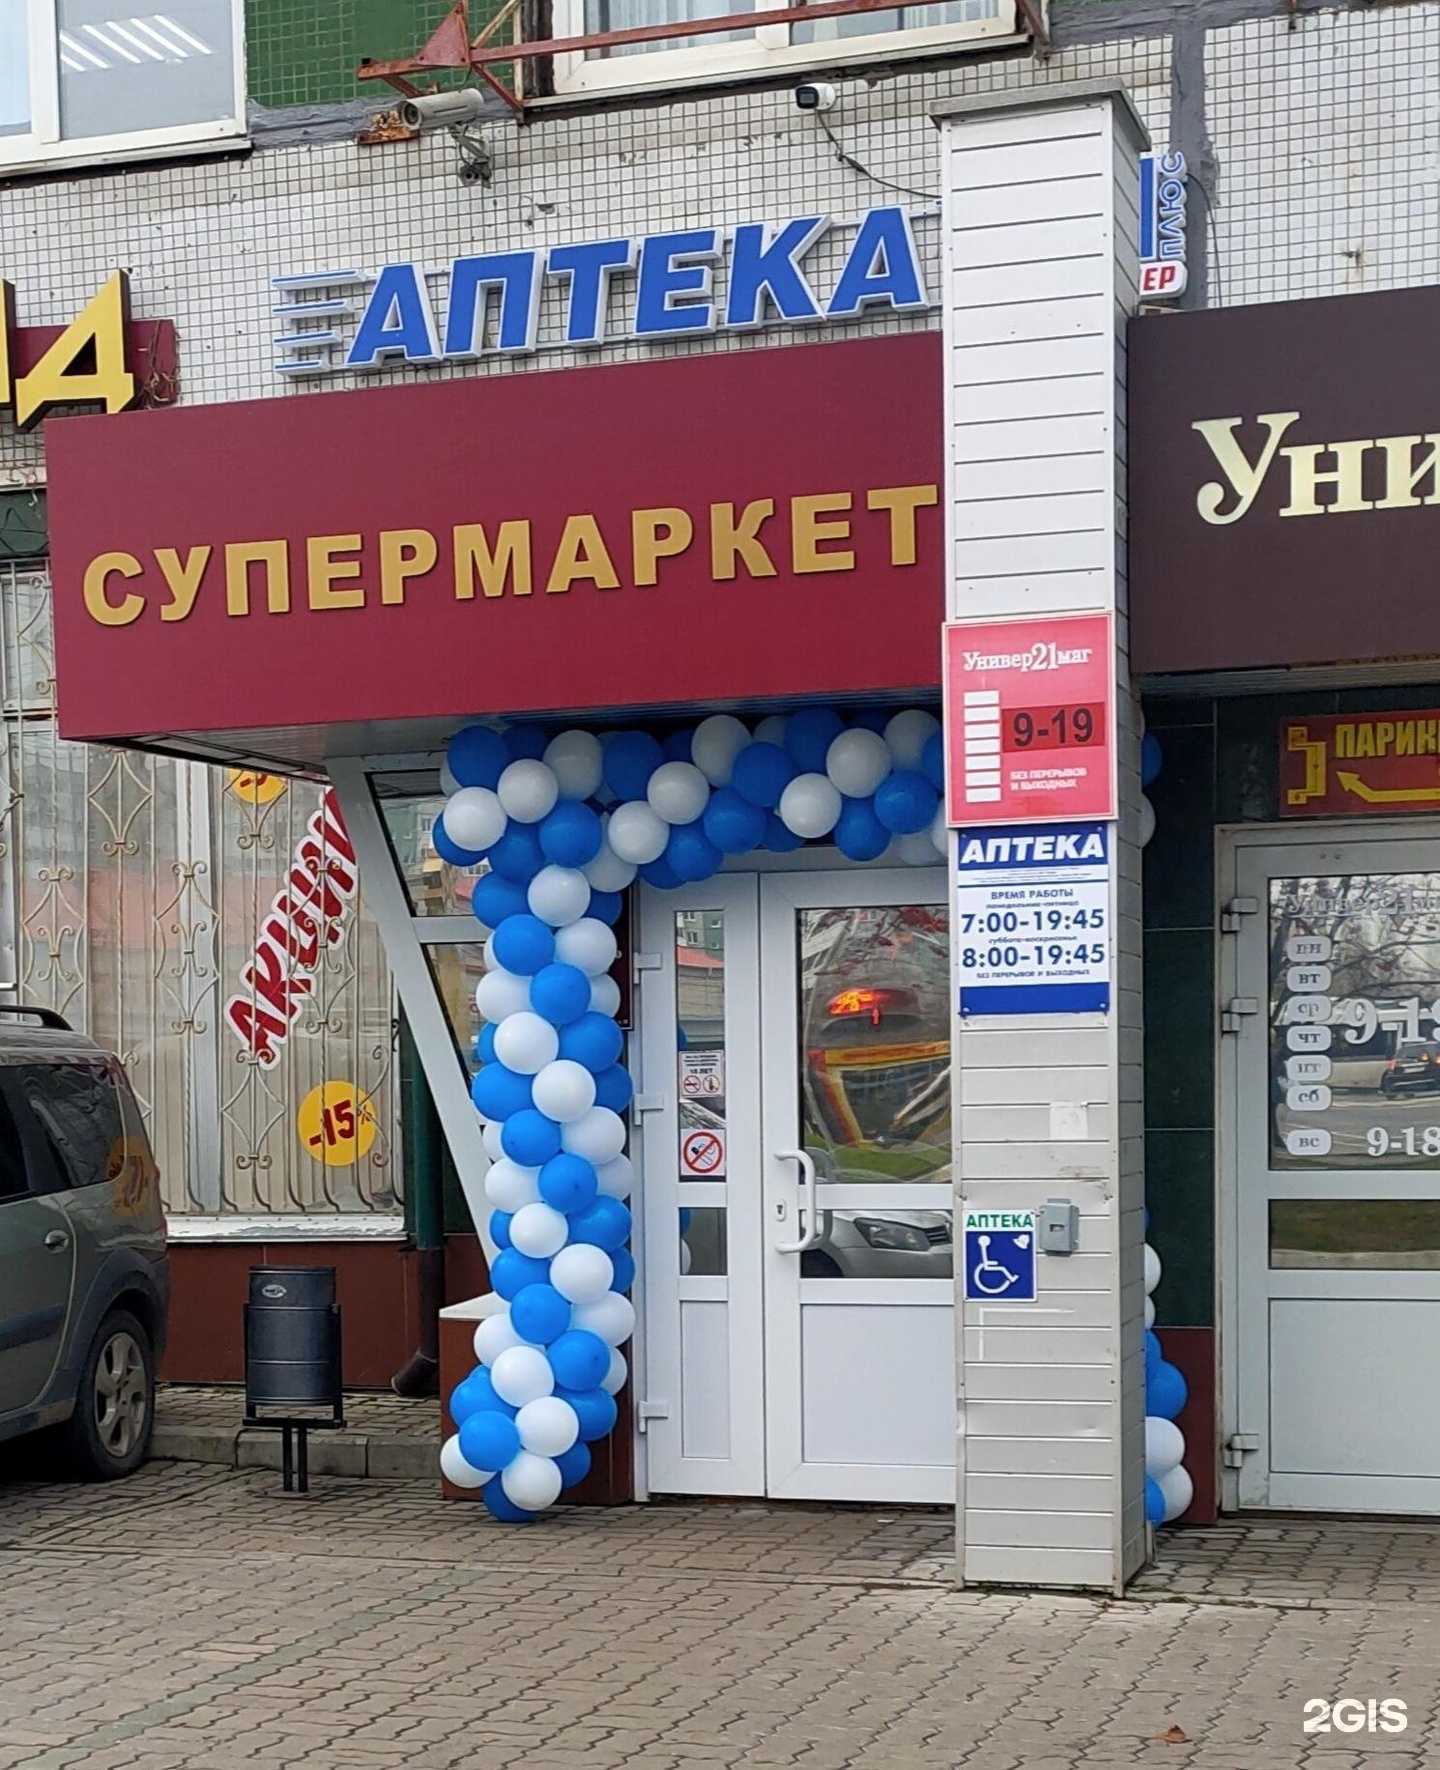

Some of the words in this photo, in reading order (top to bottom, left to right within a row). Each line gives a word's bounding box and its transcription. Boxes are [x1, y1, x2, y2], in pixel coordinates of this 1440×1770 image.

[1160, 151, 1185, 259] ПЛЮС
[343, 205, 929, 369] АПТЕКА
[1142, 265, 1176, 292] ЕР
[0, 267, 135, 427] Д
[82, 484, 939, 626] СУПЕРМАРКЕТ
[962, 643, 1093, 672] Универ21маг
[1013, 708, 1093, 747] 9-19
[1335, 720, 1440, 758] ПАРИК
[960, 833, 1105, 864] АПТЕКА
[991, 891, 1026, 900] ВРЕМЯ
[1029, 888, 1074, 898] РАБОТЫ
[961, 908, 1105, 934] 7:00-19:45
[962, 944, 1106, 968] 8:00-19:45
[1297, 973, 1321, 985] вт
[1297, 1003, 1320, 1018] ср
[1297, 1033, 1321, 1044] чт
[1297, 1088, 1320, 1103] сб
[1297, 1137, 1321, 1148] вс
[1367, 1126, 1440, 1157] 9-18
[966, 1213, 1034, 1228] АПТЕКА
